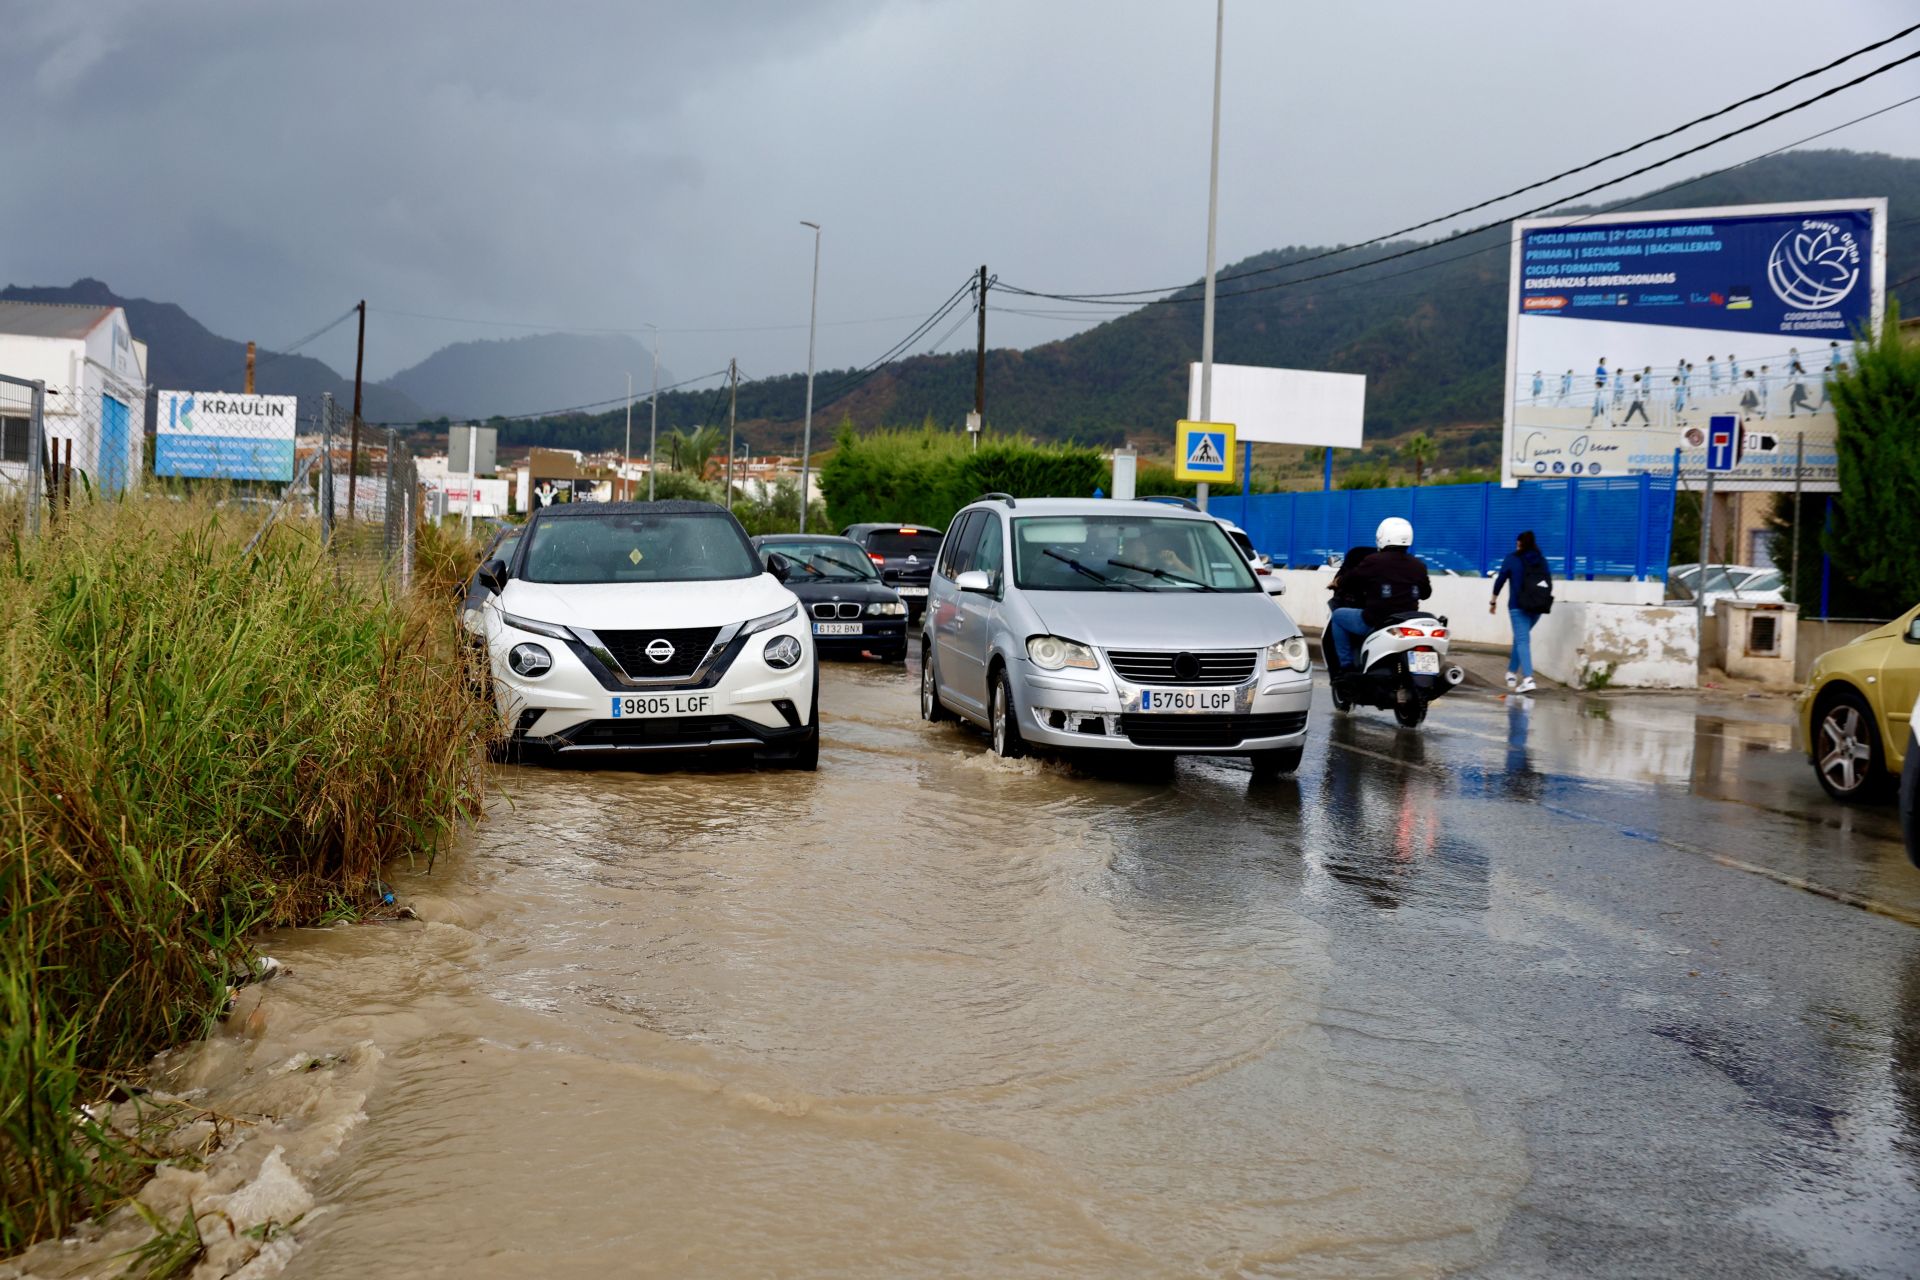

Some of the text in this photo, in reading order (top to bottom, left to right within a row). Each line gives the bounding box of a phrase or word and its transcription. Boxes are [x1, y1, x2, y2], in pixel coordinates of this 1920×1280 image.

[1566, 231, 1607, 243] INFANTIL
[1626, 228, 1653, 240] CICLO
[1656, 227, 1669, 238] DE
[1670, 225, 1714, 237] INFANTIL
[1802, 219, 1860, 264] Severo Ochoa
[1526, 241, 1722, 260] PRIMARIA SECUNDARIA BACHILLERATO
[1525, 261, 1620, 275] CICLOS FORMATIVOS
[1525, 273, 1676, 289] ENSEÑANZAS SUBVENCIONADAS
[203, 400, 285, 417] KRAULIN
[819, 624, 861, 633] 6132 BNX
[625, 696, 709, 714] 9805 LGF
[1153, 693, 1195, 708] 5760
[1201, 693, 1230, 709] LGP
